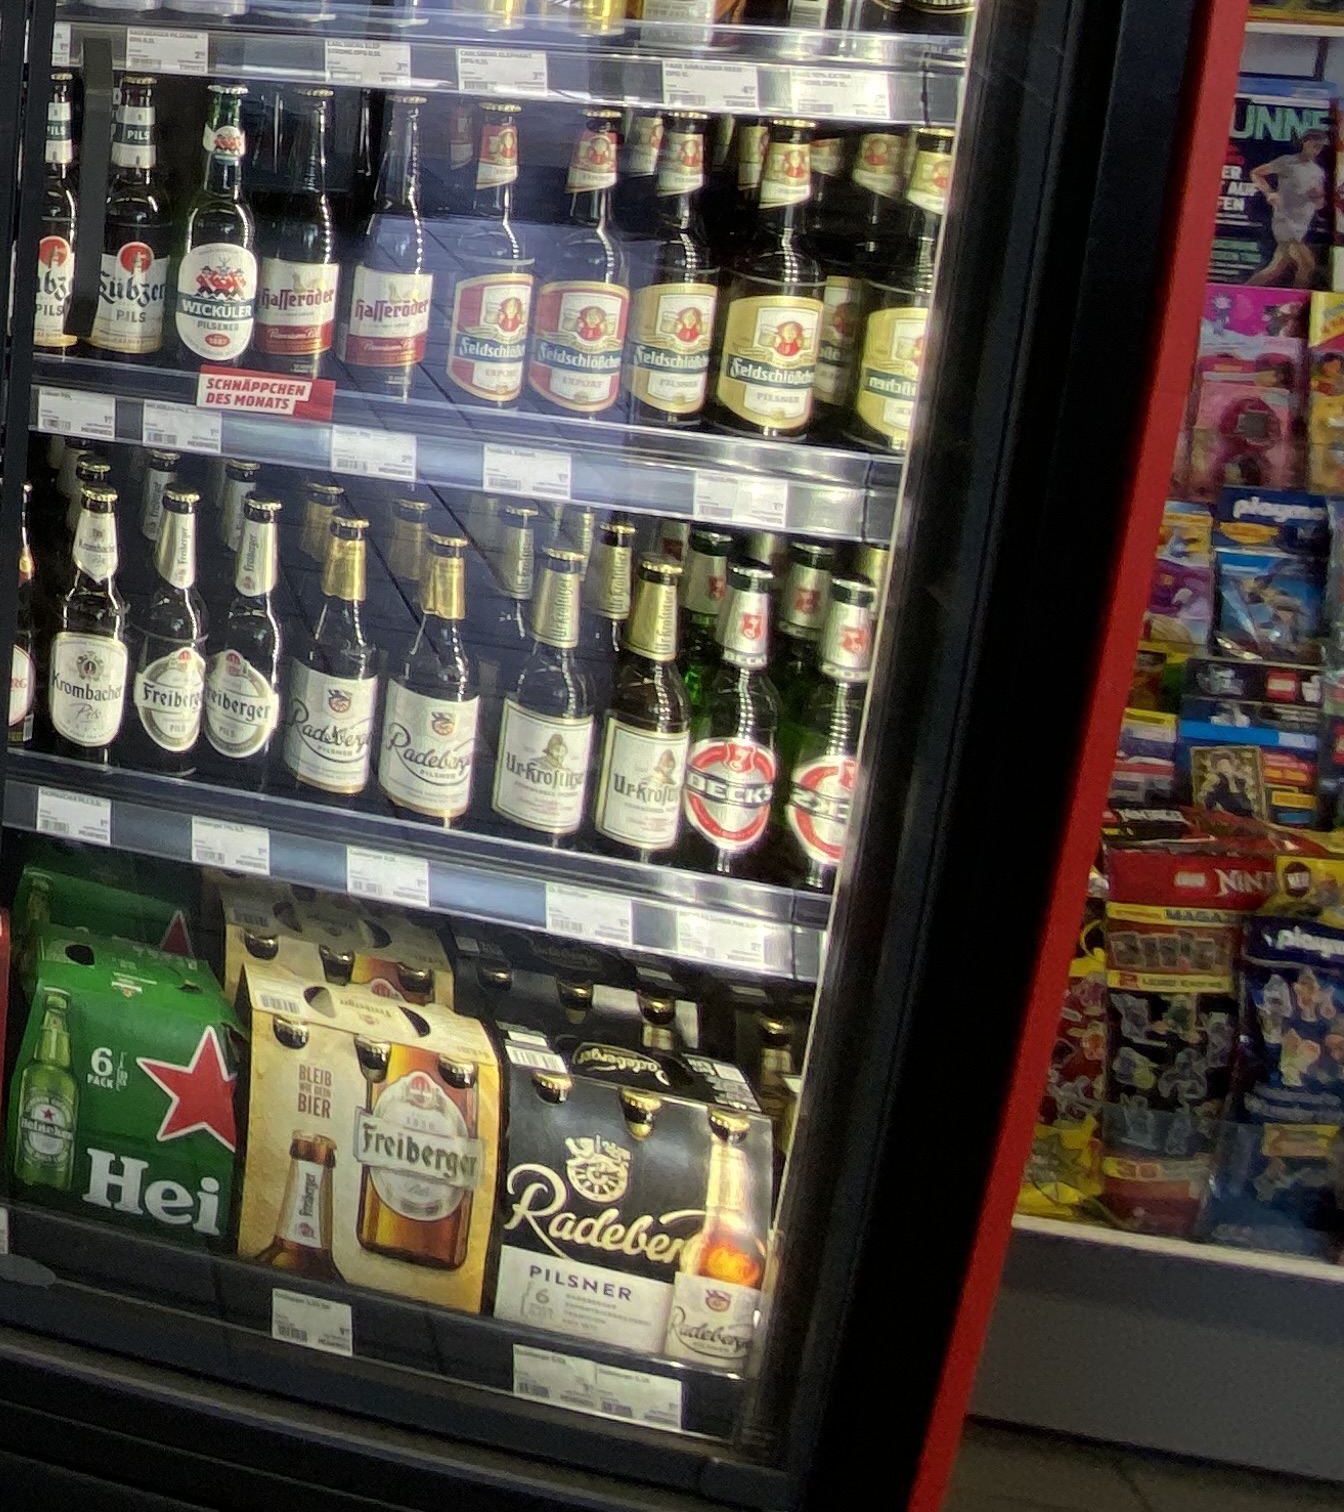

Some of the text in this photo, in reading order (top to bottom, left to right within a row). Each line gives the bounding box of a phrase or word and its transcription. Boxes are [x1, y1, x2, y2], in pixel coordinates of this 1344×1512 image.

[125, 127, 151, 141] PILS
[116, 308, 147, 324] PILS
[181, 298, 252, 319] WICKÜLER
[196, 320, 240, 332] PILSENER
[205, 376, 306, 397] SCHNÄPPCHEN
[205, 391, 291, 411] DES MONATS
[756, 391, 800, 405] PILSNER
[91, 1046, 114, 1077] 6
[86, 1073, 114, 1089] PACK
[299, 1063, 332, 1087] BLEIB
[298, 1093, 332, 1120] BIER
[361, 1121, 478, 1179] Freiberger
[528, 1263, 634, 1304] PILSNER
